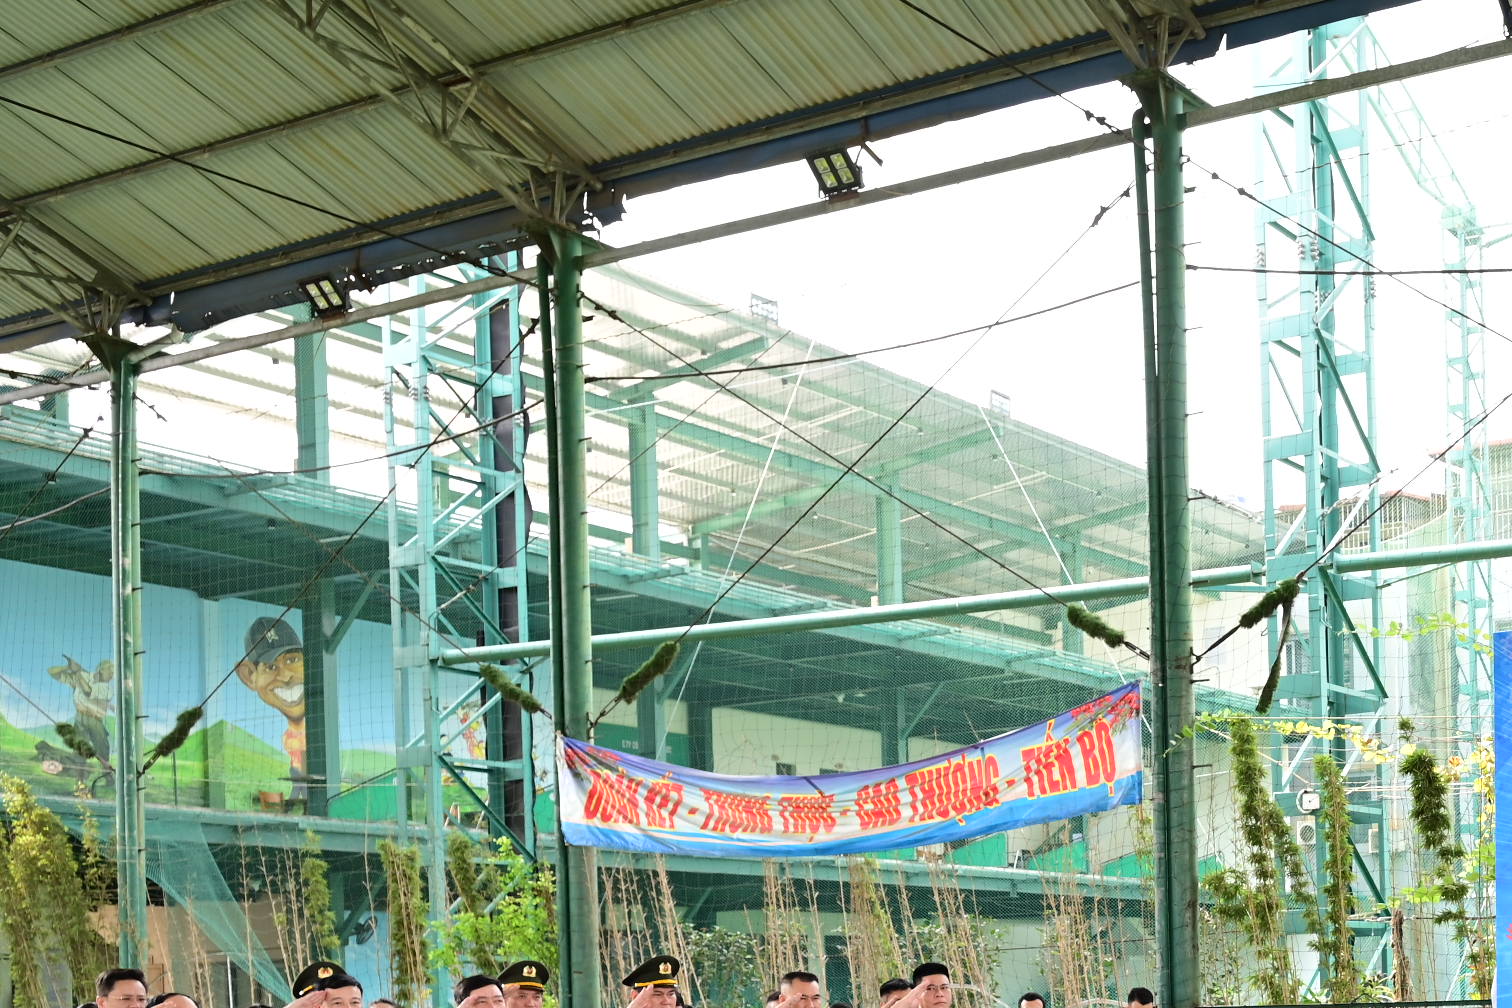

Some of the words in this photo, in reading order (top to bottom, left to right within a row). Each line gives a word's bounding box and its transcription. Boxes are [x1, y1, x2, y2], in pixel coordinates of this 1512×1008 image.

[905, 752, 1001, 826] THƯỢNG
[1020, 719, 1078, 800] TIẾN
[1075, 715, 1117, 797] BỘ
